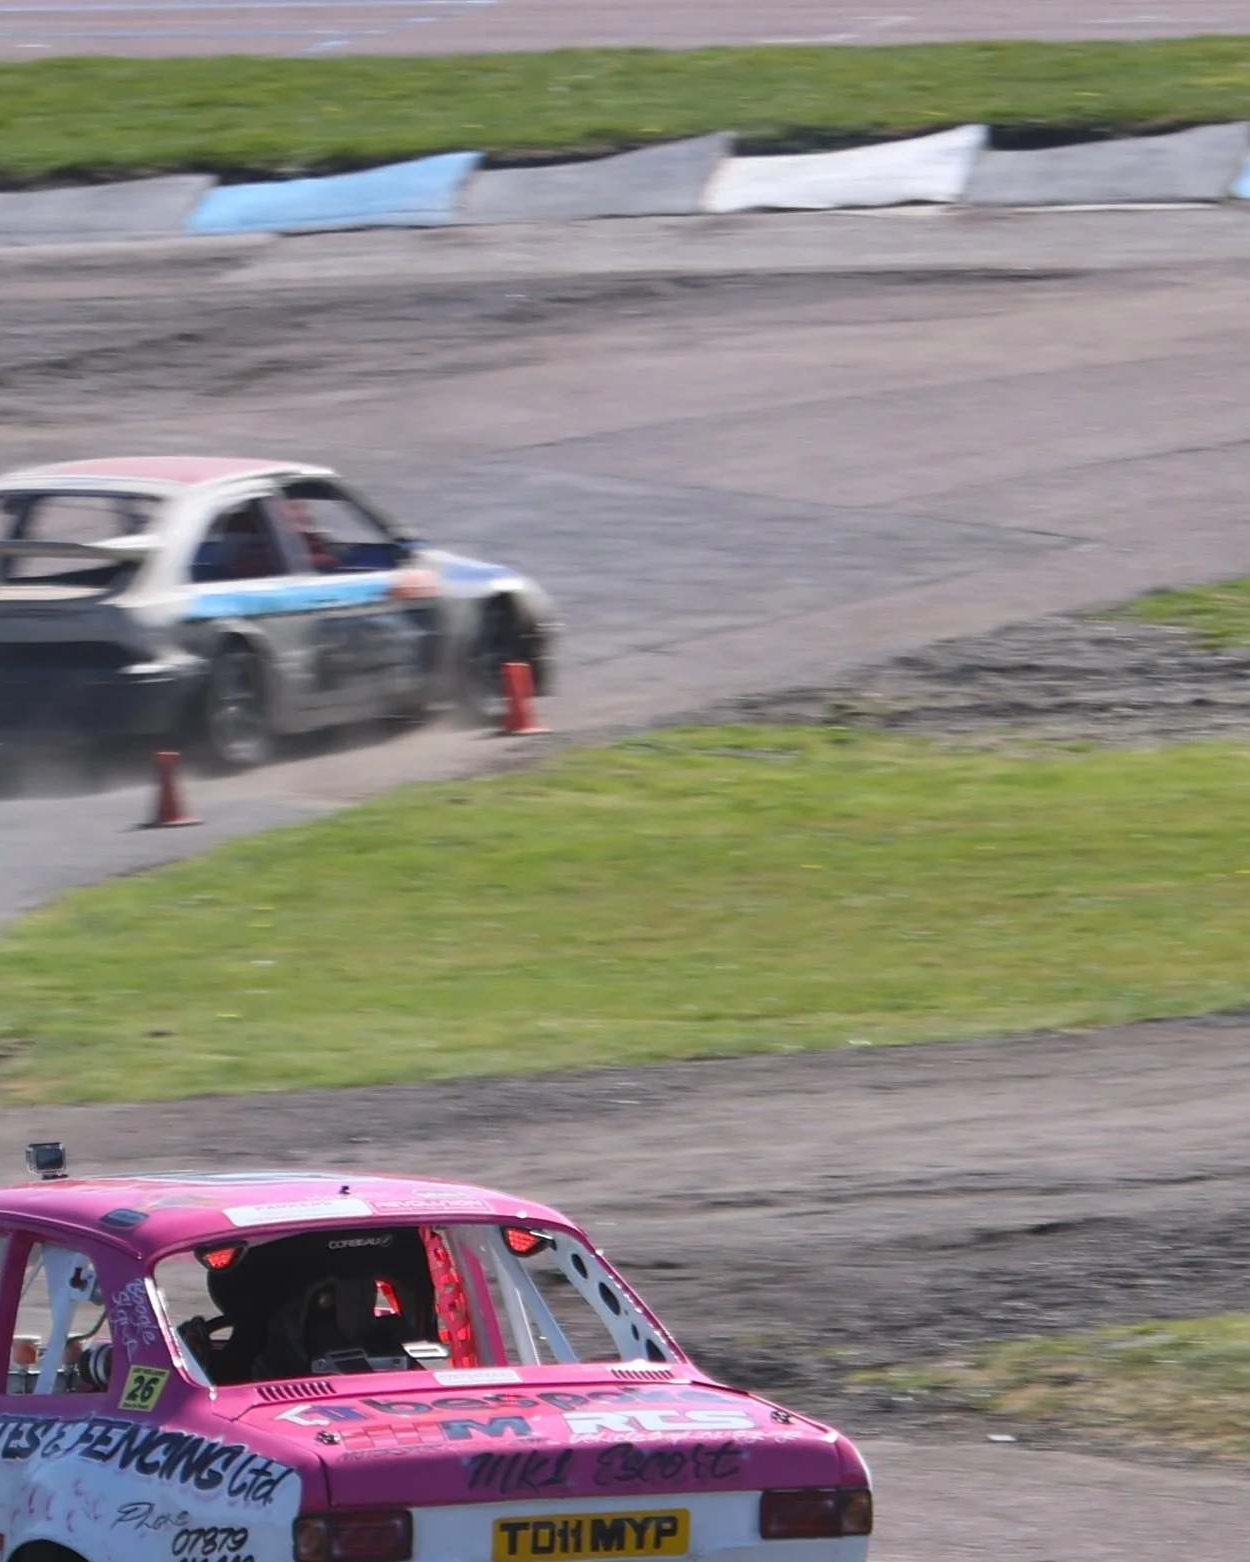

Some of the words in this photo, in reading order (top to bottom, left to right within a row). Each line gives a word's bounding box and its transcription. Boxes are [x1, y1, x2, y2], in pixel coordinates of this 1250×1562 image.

[327, 1236, 380, 1250] CORBEAU
[125, 1375, 160, 1403] 26
[79, 1416, 247, 1490] FENCING
[593, 1442, 742, 1487] Escort
[171, 1526, 248, 1555] 07879
